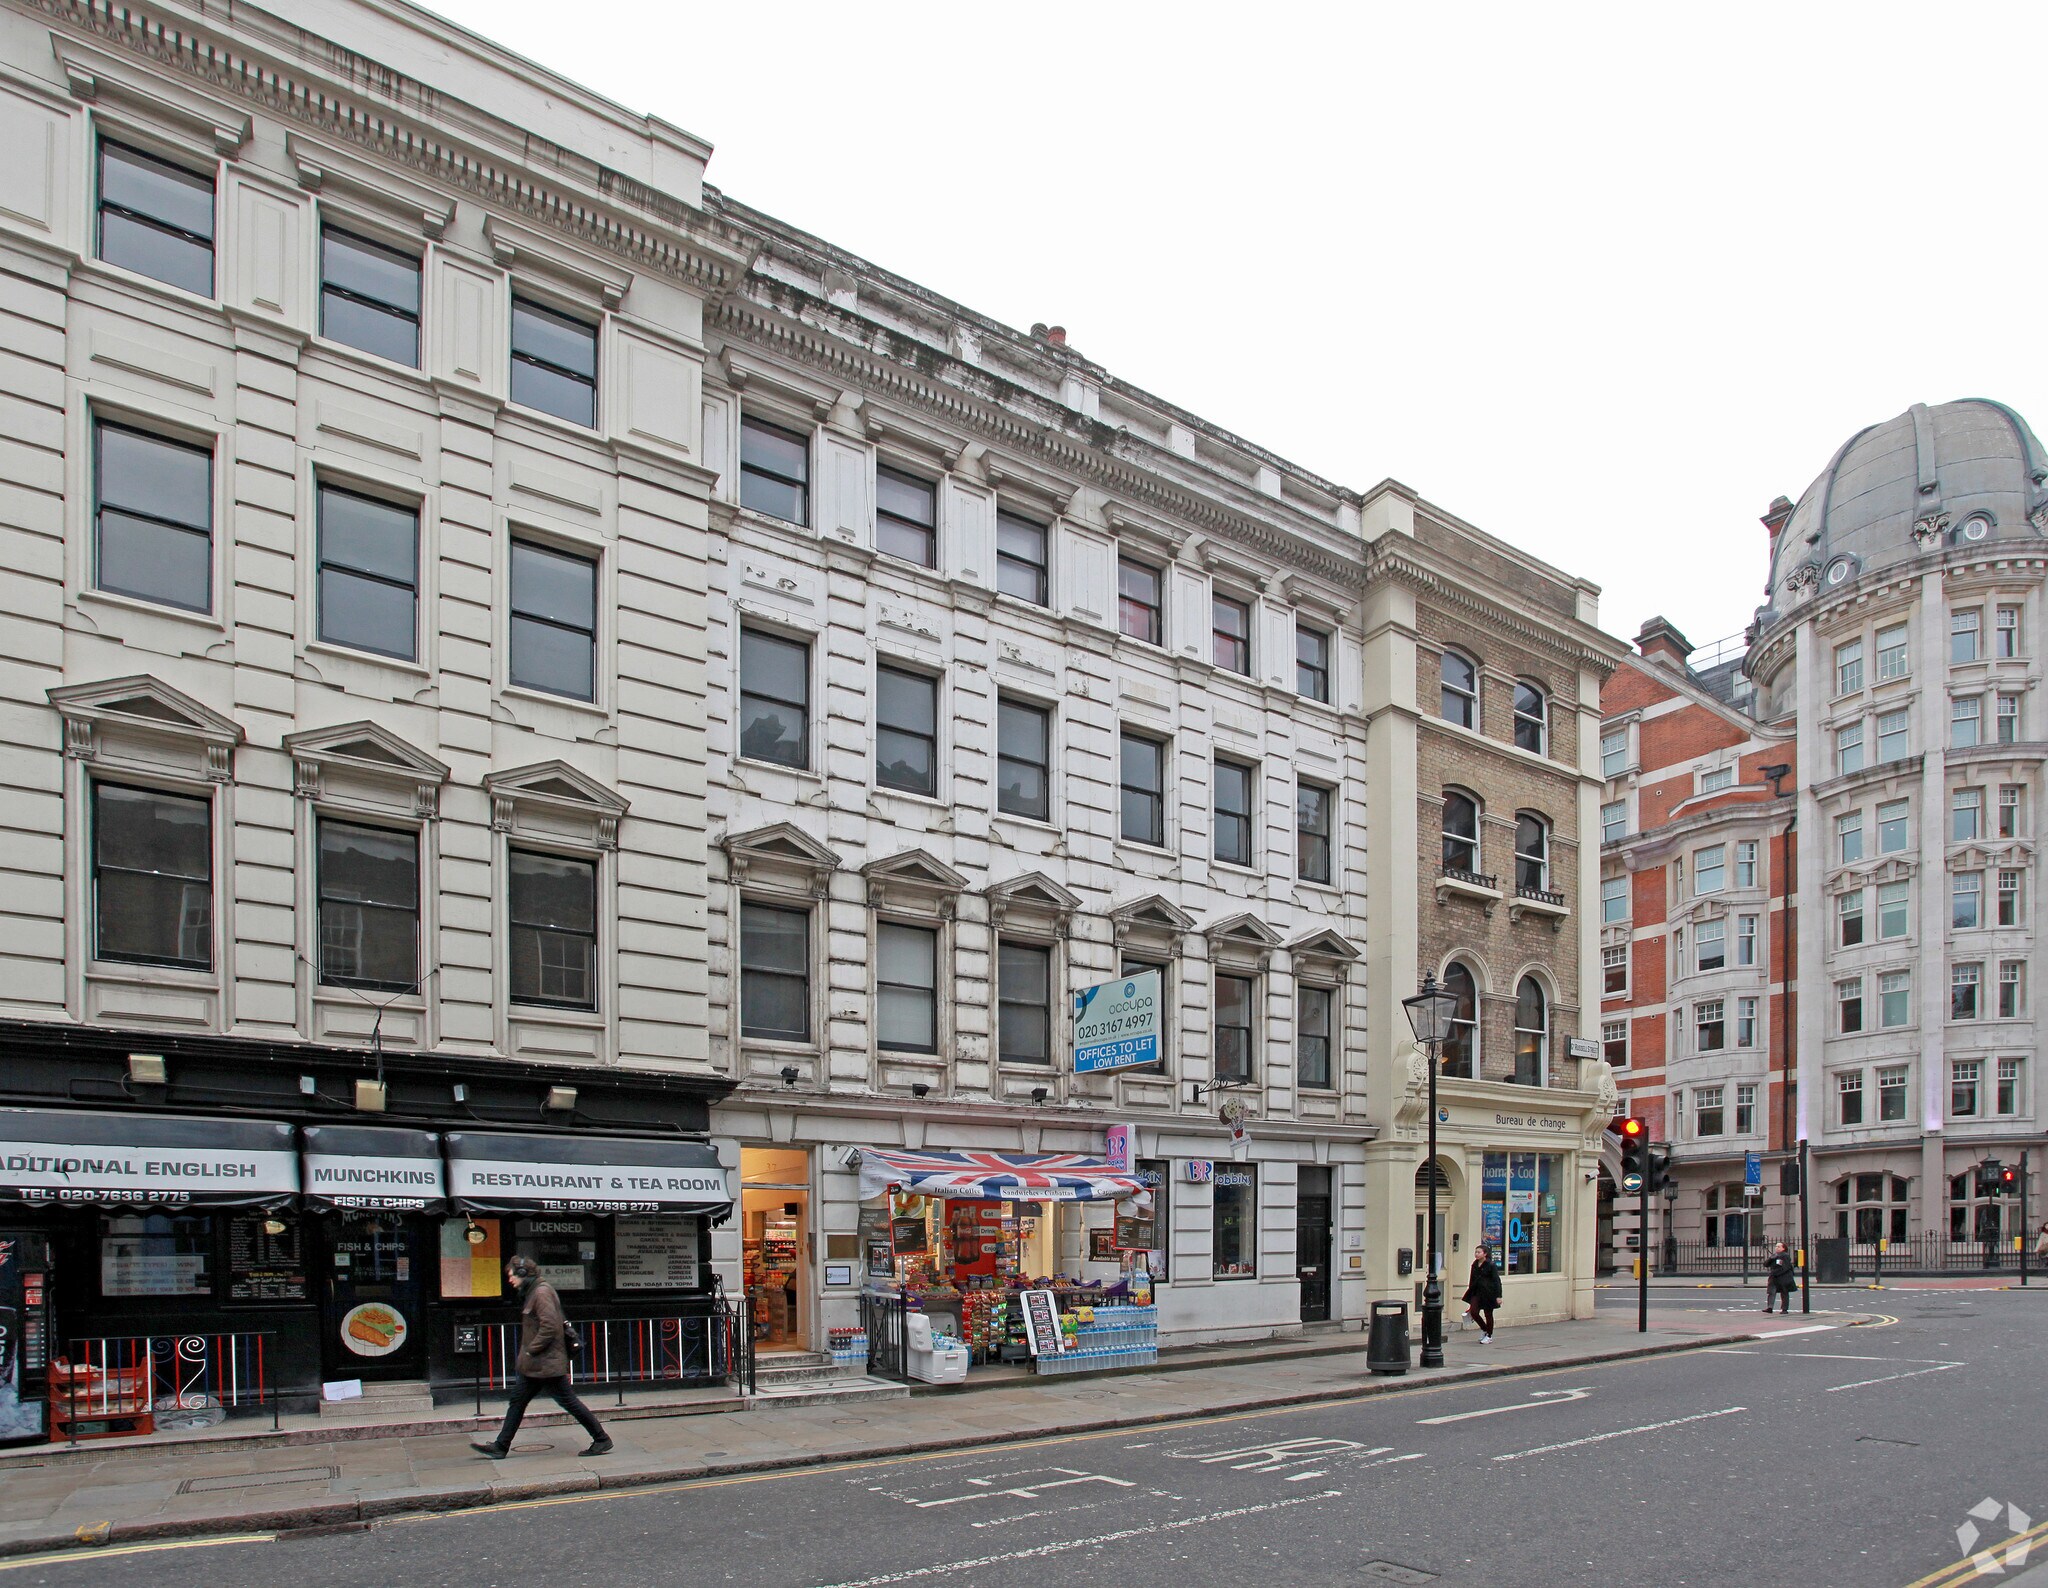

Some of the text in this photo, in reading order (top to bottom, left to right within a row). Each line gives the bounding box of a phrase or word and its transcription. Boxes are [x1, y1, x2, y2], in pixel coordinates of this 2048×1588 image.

[1109, 996, 1153, 1015] occupa
[1078, 1012, 1153, 1040] 020 3167 4997
[1078, 1037, 1153, 1061] OFFICES TO LET
[1093, 1053, 1137, 1069] LOW RENT
[1496, 1114, 1566, 1131] Bureau de change
[1108, 1135, 1126, 1157] BR
[145, 1161, 256, 1178] ENGLISH
[314, 1168, 436, 1185] MUNCHKINS
[1188, 1160, 1213, 1181] BR
[1517, 1165, 1535, 1179] Coo
[472, 1172, 721, 1191] RESTAURANT & TEA ROOM
[18, 1188, 191, 1202] TEL: 020-7636 2775
[934, 1186, 981, 1195] Italian Coffee
[1002, 1189, 1039, 1197] Sandwiches
[334, 1196, 425, 1209] FISH & CHIPS
[542, 1200, 659, 1211] TEL: 020-7636 2775
[530, 1221, 582, 1233] LICENSED
[1510, 1217, 1528, 1242] 0%
[337, 1242, 406, 1251] FISH & CHIPS
